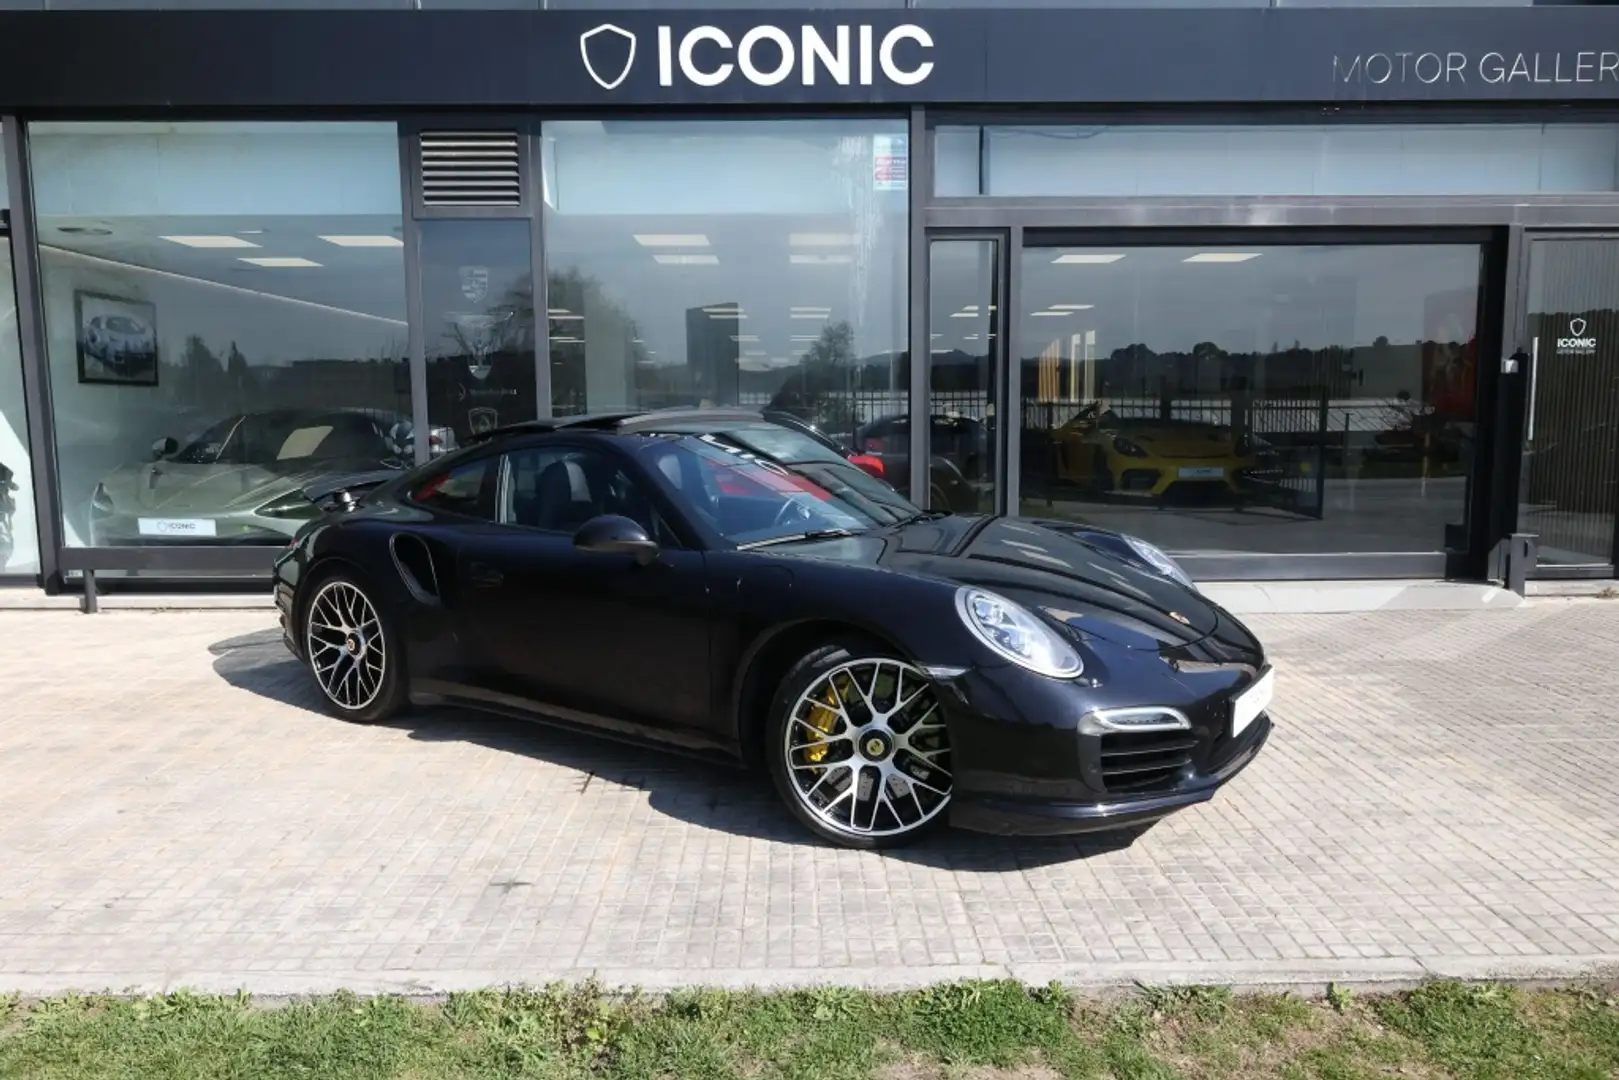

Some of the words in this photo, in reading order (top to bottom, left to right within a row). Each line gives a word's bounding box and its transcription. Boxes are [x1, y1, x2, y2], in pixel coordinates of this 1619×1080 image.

[658, 24, 935, 86] ICONIC
[1333, 51, 1468, 84] MOTOR
[1557, 338, 1597, 348] ICONIC
